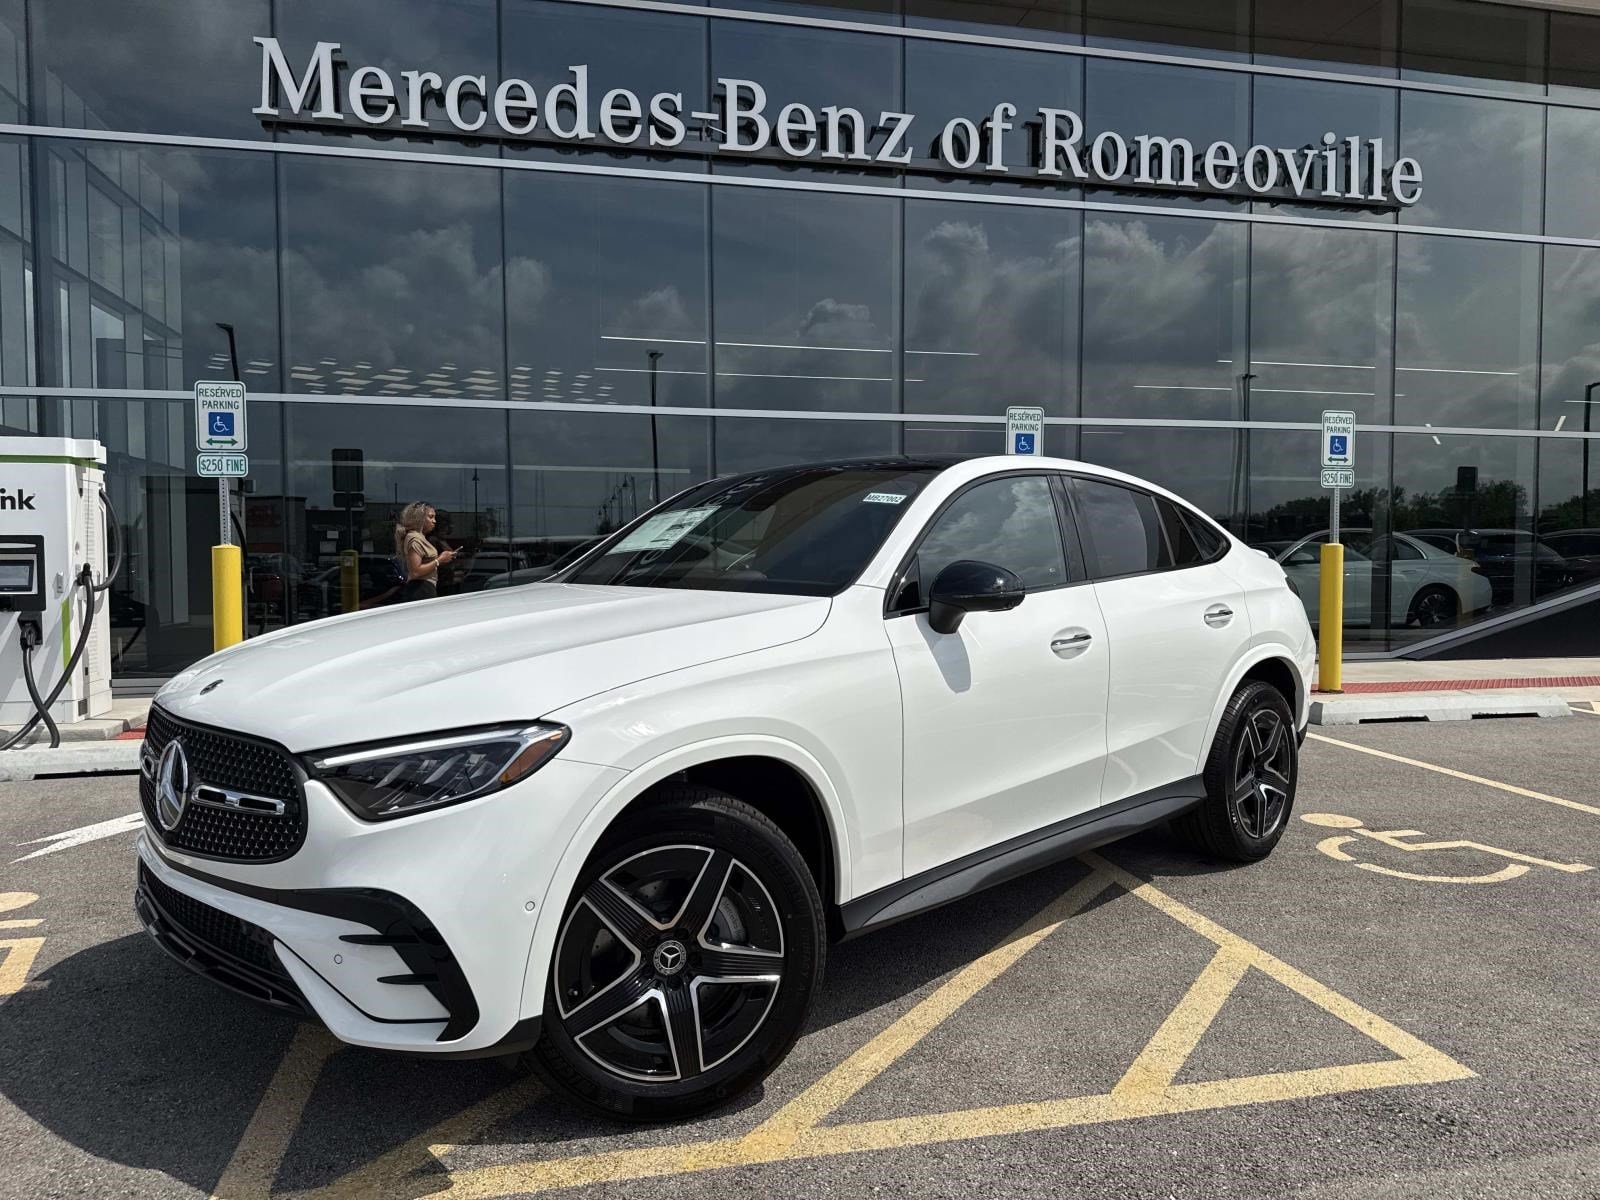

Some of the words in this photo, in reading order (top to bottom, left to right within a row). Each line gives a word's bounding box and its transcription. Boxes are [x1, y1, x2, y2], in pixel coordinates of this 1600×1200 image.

[252, 36, 915, 164] Mercedes-Benz
[941, 102, 1018, 172] of
[1037, 107, 1423, 204] Romeoville
[198, 388, 242, 398] RESERVED
[202, 400, 240, 409] PARKING
[1009, 412, 1041, 422] RESERVED
[1324, 416, 1353, 425] RESERVED
[1011, 423, 1039, 432] PARKING
[1326, 425, 1351, 434] PARKING
[200, 458, 223, 472] $250
[226, 459, 244, 472] FINE
[1323, 473, 1337, 484] $250
[1340, 473, 1352, 484] FINE
